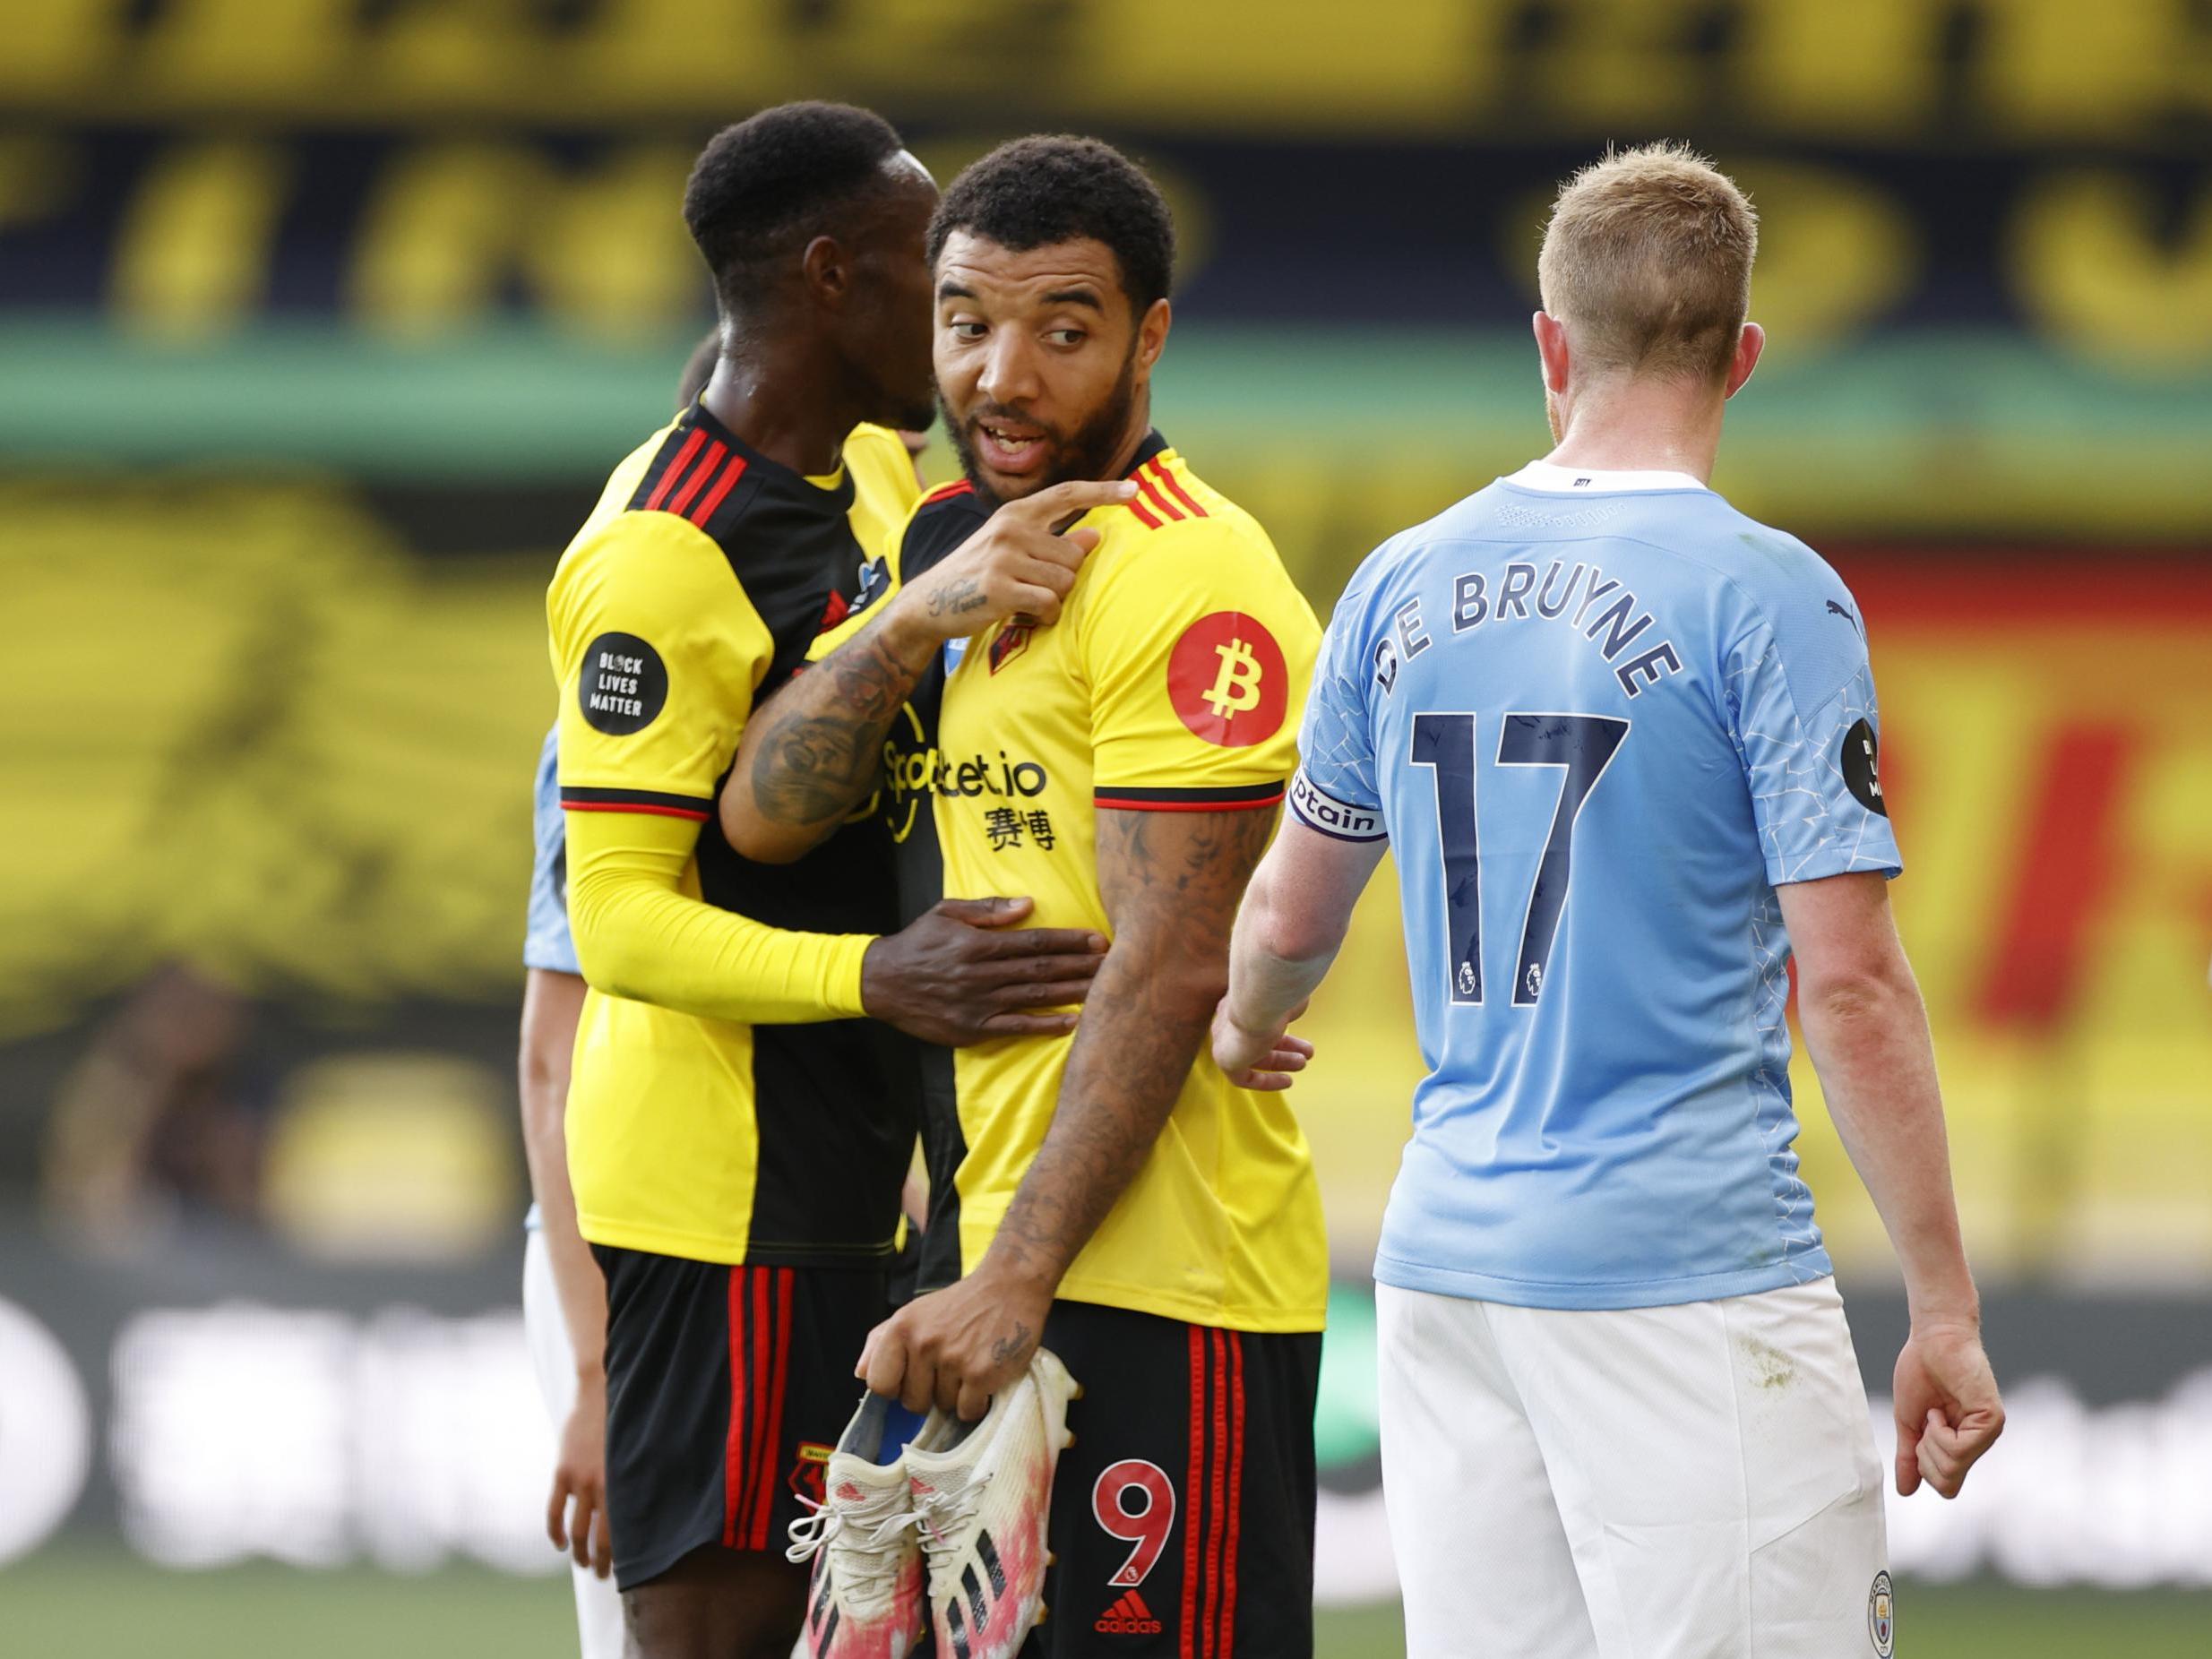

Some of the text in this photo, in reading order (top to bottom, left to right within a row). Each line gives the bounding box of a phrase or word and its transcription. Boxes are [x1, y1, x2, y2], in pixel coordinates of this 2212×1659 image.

[1373, 560, 1683, 700] DE BRUYNE
[598, 673, 638, 694] LIVES
[599, 651, 643, 675] BLCK
[590, 692, 642, 717] MATTER
[1294, 776, 1374, 830] ptain
[985, 807, 1055, 851] 赛博
[1409, 712, 1631, 1007] 17
[1091, 1458, 1175, 1586] 9
[1094, 1617, 1162, 1634] adidas
